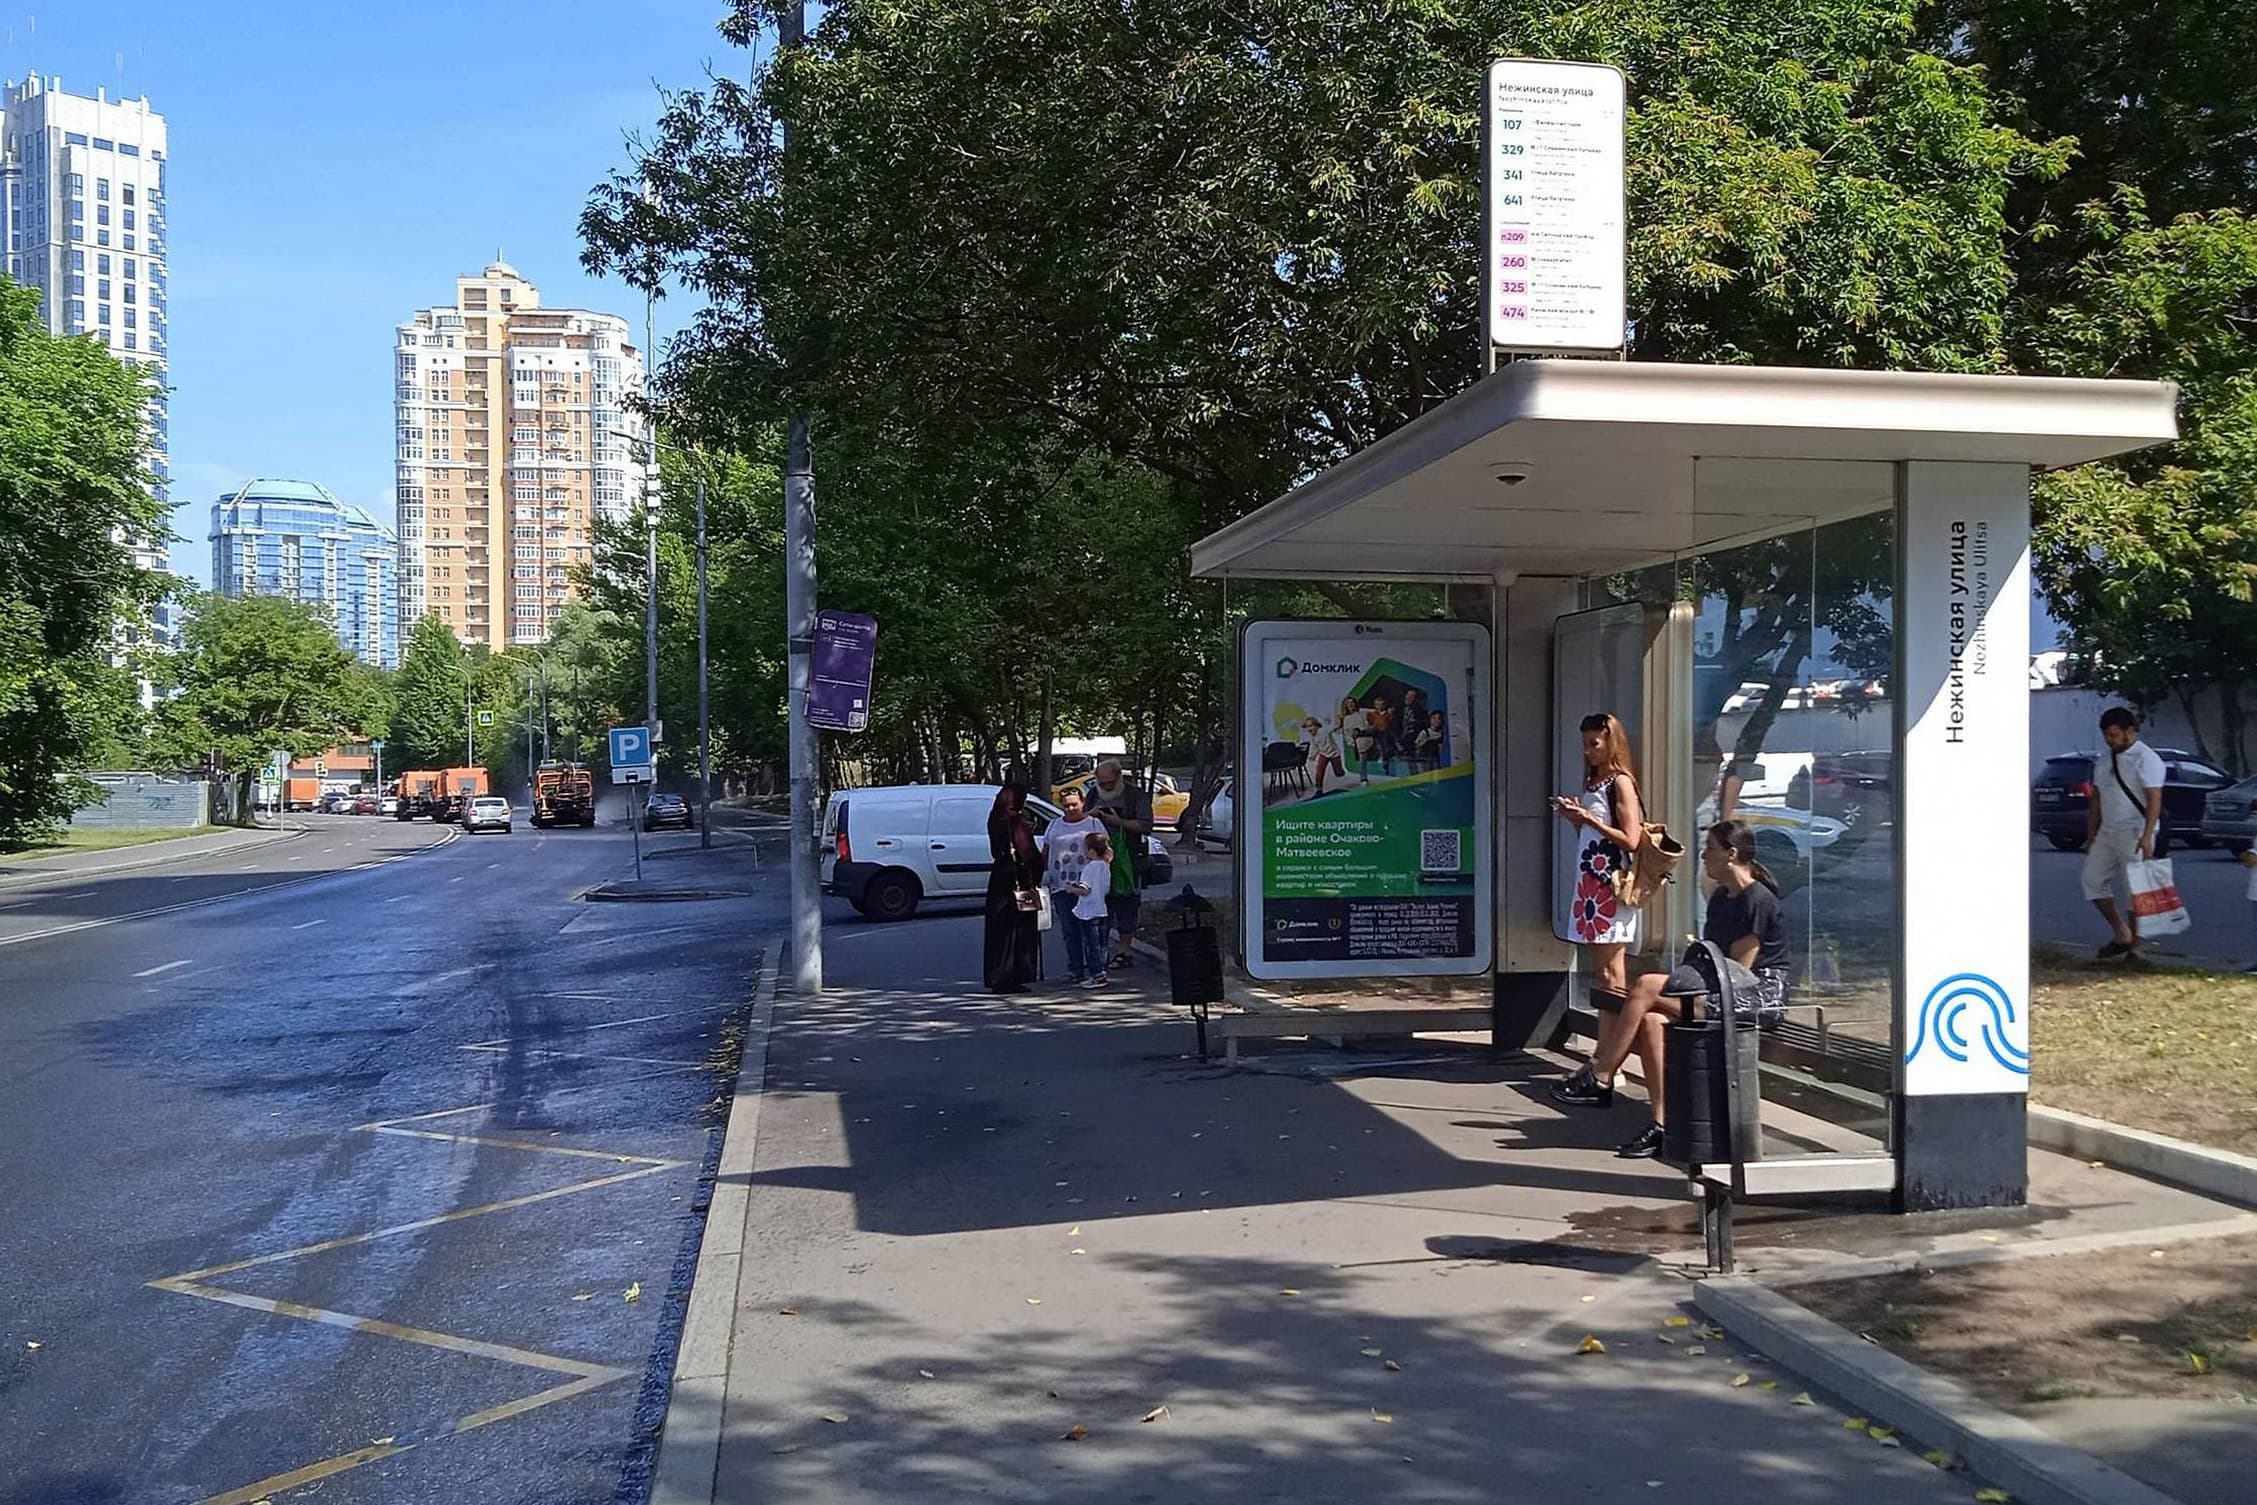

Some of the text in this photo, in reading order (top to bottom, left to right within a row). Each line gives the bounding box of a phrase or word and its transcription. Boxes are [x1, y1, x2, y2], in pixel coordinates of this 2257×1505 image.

[1499, 83, 1594, 97] Нежинская улица
[1503, 119, 1522, 130] 107
[1501, 144, 1524, 155] 329
[1503, 170, 1522, 181] 341
[1503, 195, 1523, 206] 641
[1502, 257, 1525, 268] 260
[1502, 282, 1525, 293] 325
[1502, 307, 1525, 318] 474
[1973, 521, 1989, 675] Nezhinskaya Ulitsa
[1946, 521, 1969, 743] Нежинская улица
[1301, 662, 1361, 674] Домклик
[618, 734, 640, 761] P
[1276, 819, 1374, 832] Ищите квартиры
[1276, 832, 1384, 846] в районе Очаково-
[1276, 847, 1352, 857] Матвеевское
